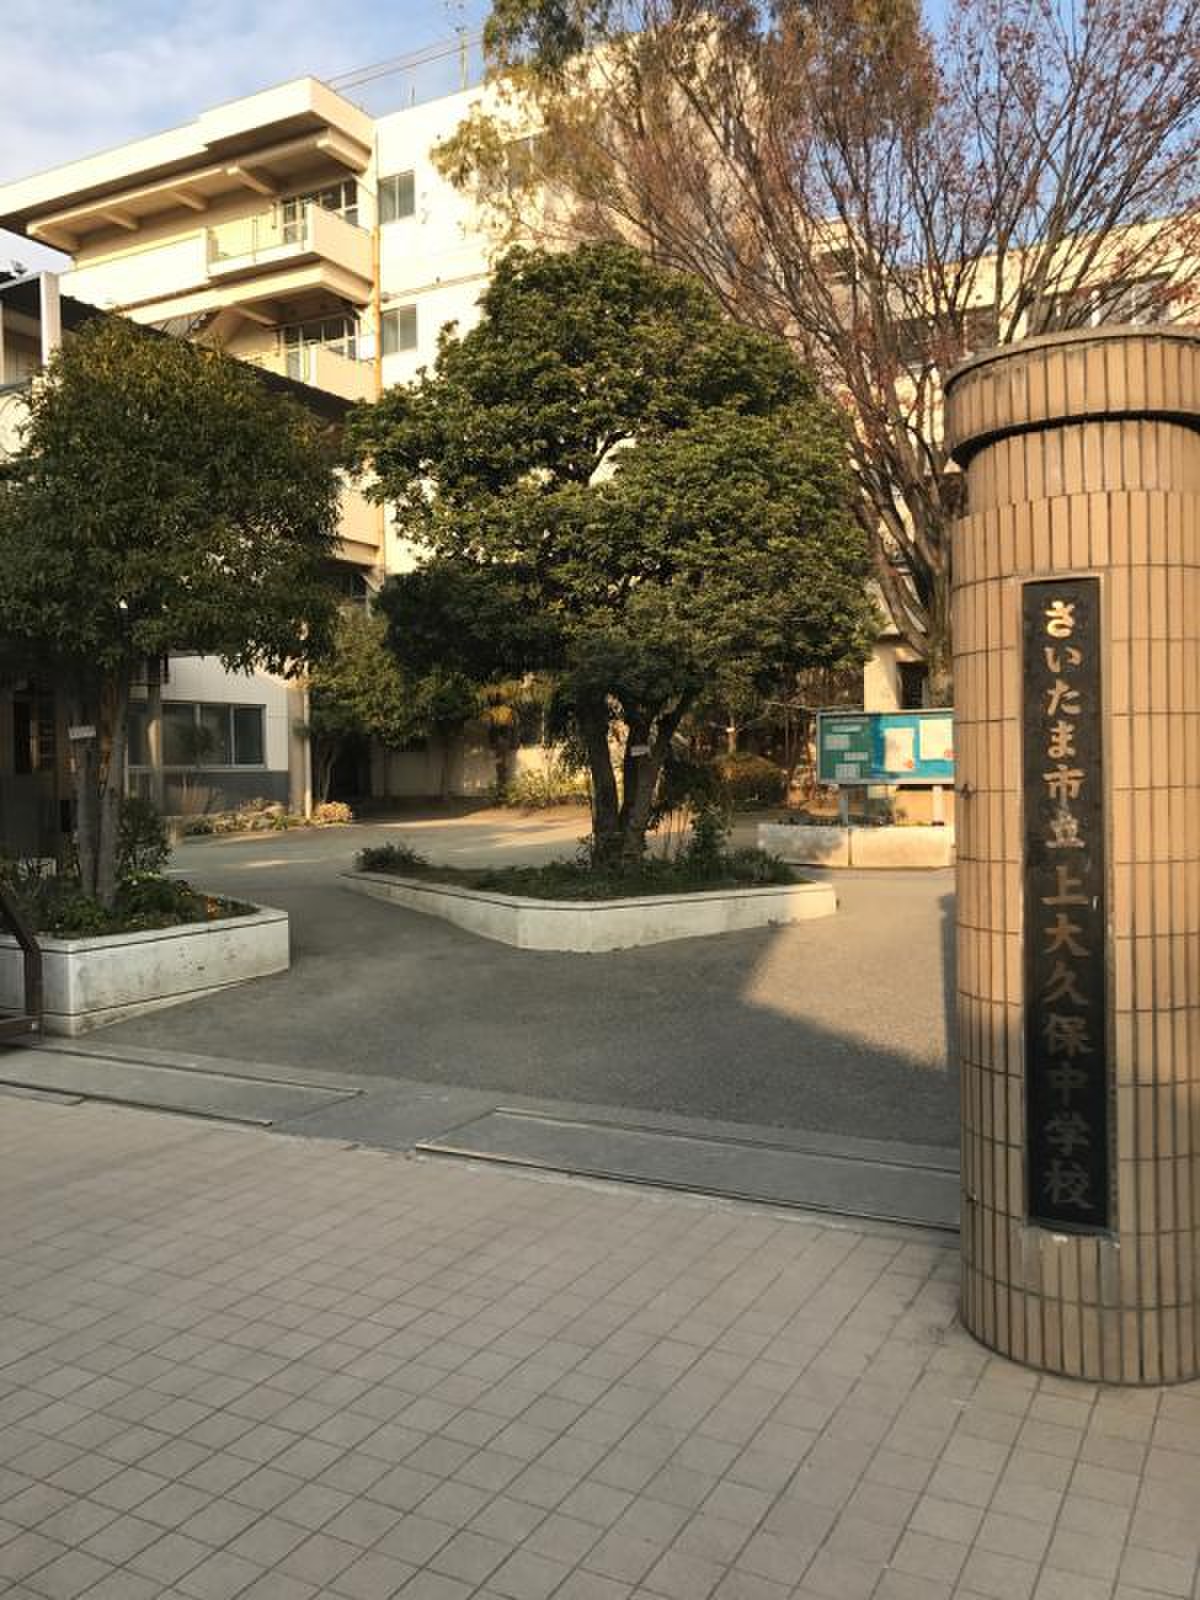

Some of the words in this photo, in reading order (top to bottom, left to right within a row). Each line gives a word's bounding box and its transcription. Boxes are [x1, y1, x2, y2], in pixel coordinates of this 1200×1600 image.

[1041, 600, 1094, 1210] さいたま市立上大久保中学校
